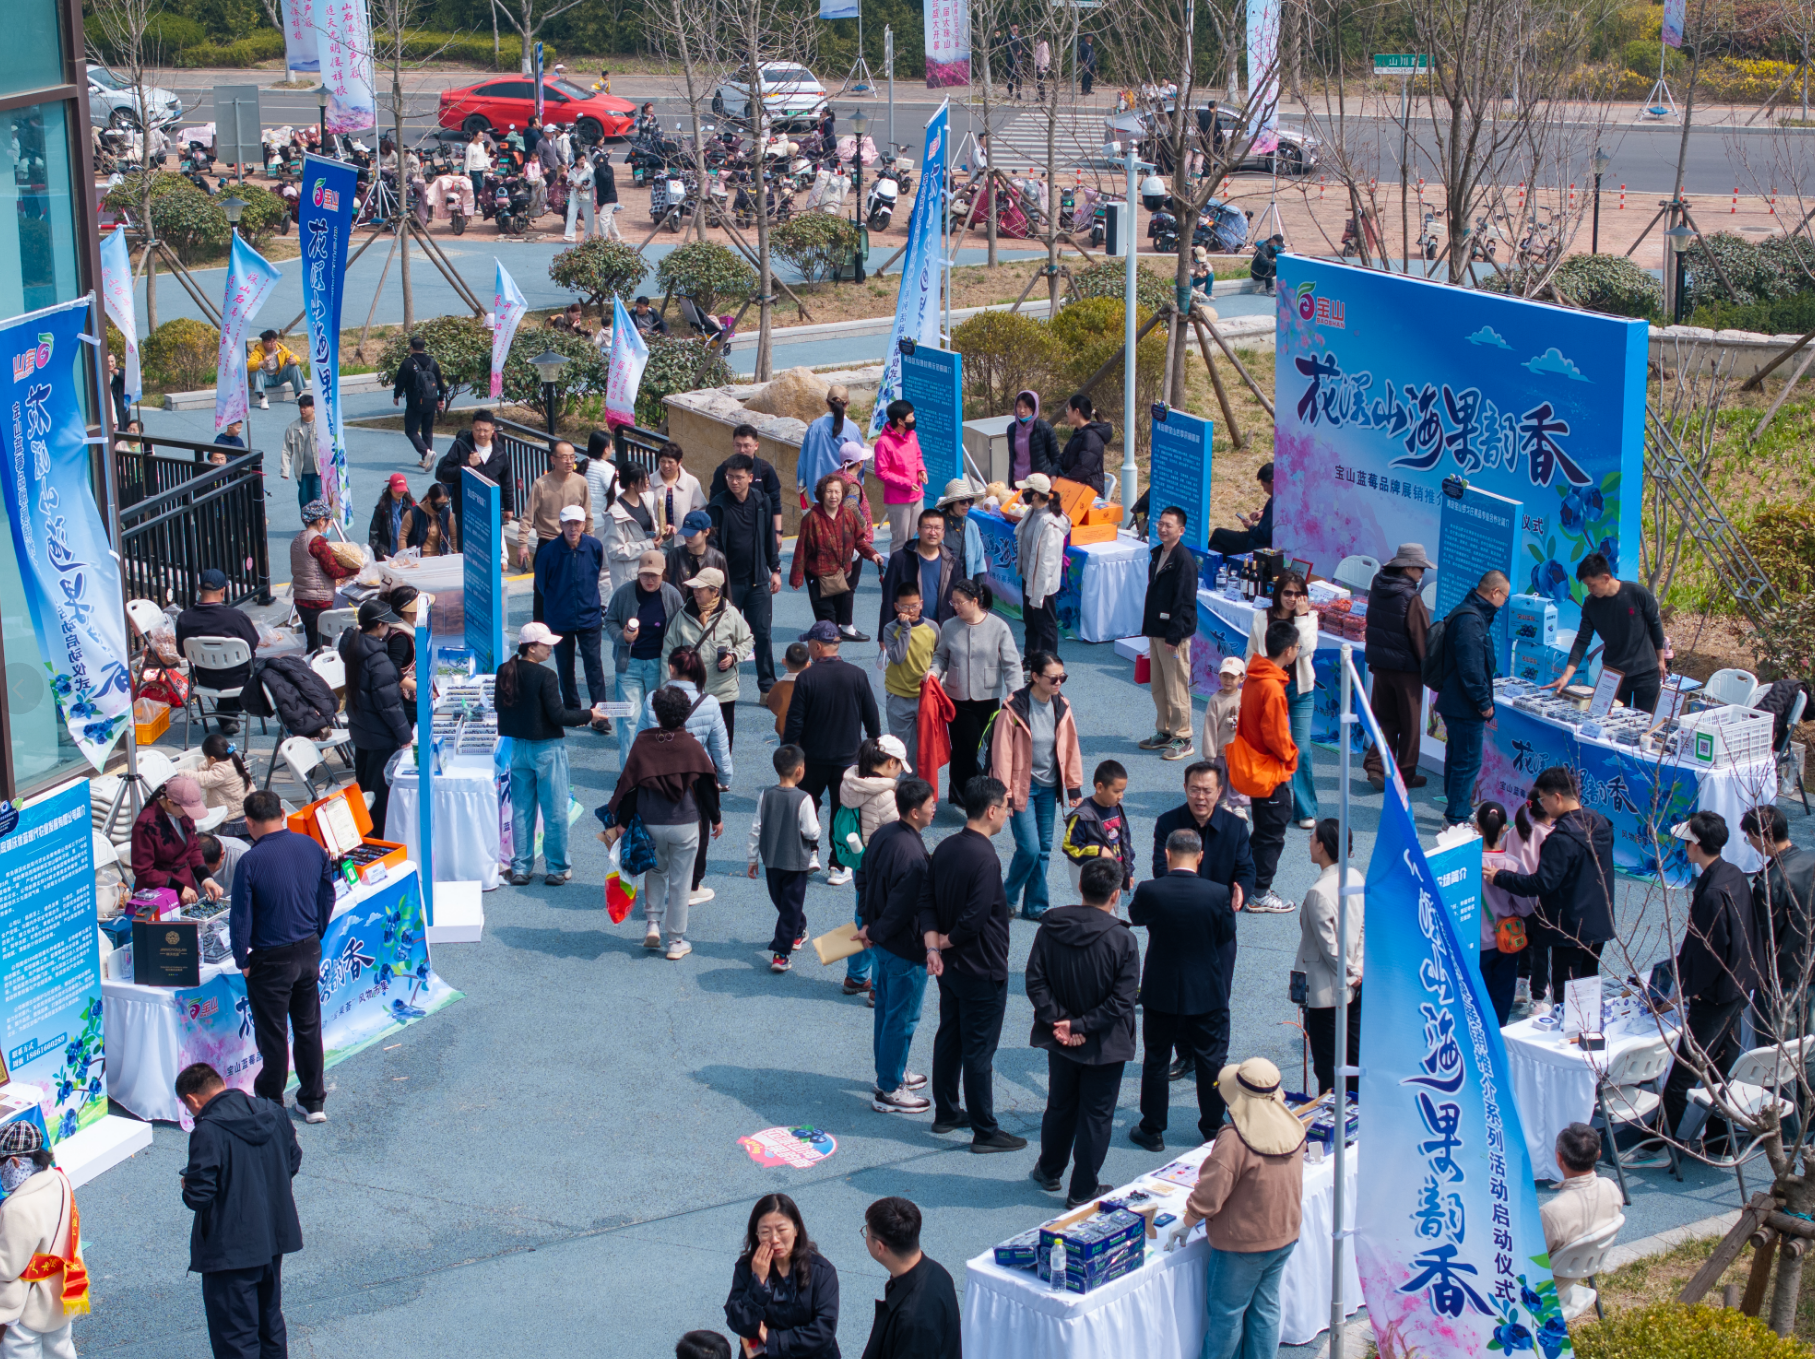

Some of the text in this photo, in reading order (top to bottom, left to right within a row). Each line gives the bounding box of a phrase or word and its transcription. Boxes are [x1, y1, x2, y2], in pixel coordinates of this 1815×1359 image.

[1317, 296, 1345, 322] 宝山
[1316, 317, 1346, 330] BAOSHAN
[358, 979, 390, 1005] 风物市集
[202, 996, 219, 1013] 宝山
